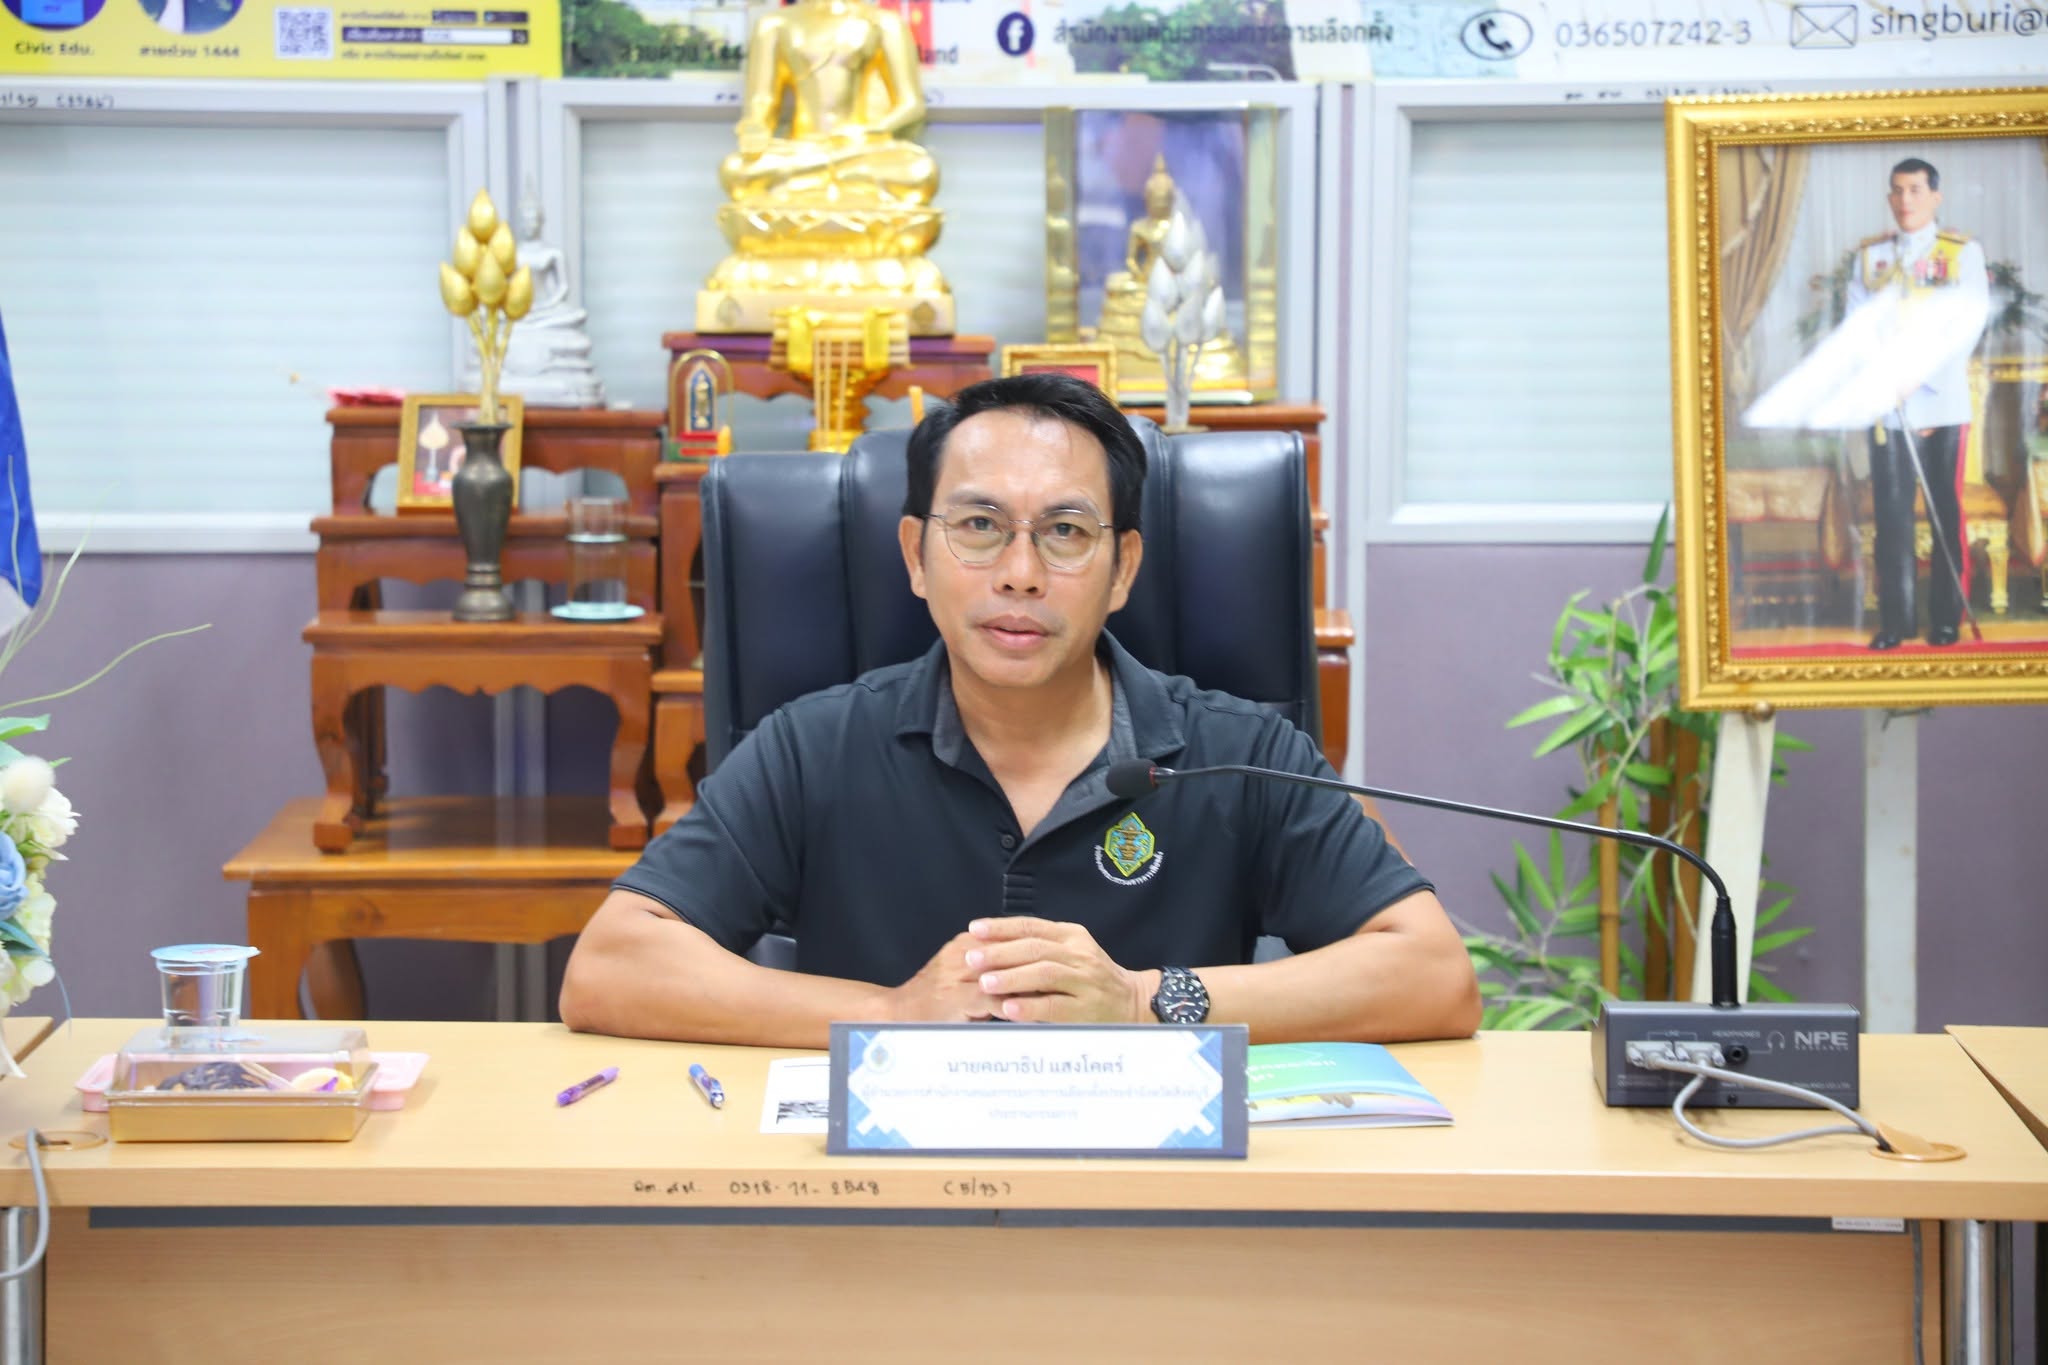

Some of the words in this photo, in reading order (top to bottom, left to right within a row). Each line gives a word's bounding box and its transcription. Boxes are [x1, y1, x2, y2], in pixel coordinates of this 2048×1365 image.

[1871, 3, 2048, 42] singburi@
[1555, 20, 1752, 48] 036507242-3
[14, 42, 54, 56] Civic
[59, 41, 95, 57] Edu.
[1793, 1031, 1849, 1046] NPE
[947, 1055, 1044, 1075] นายคณาธิป
